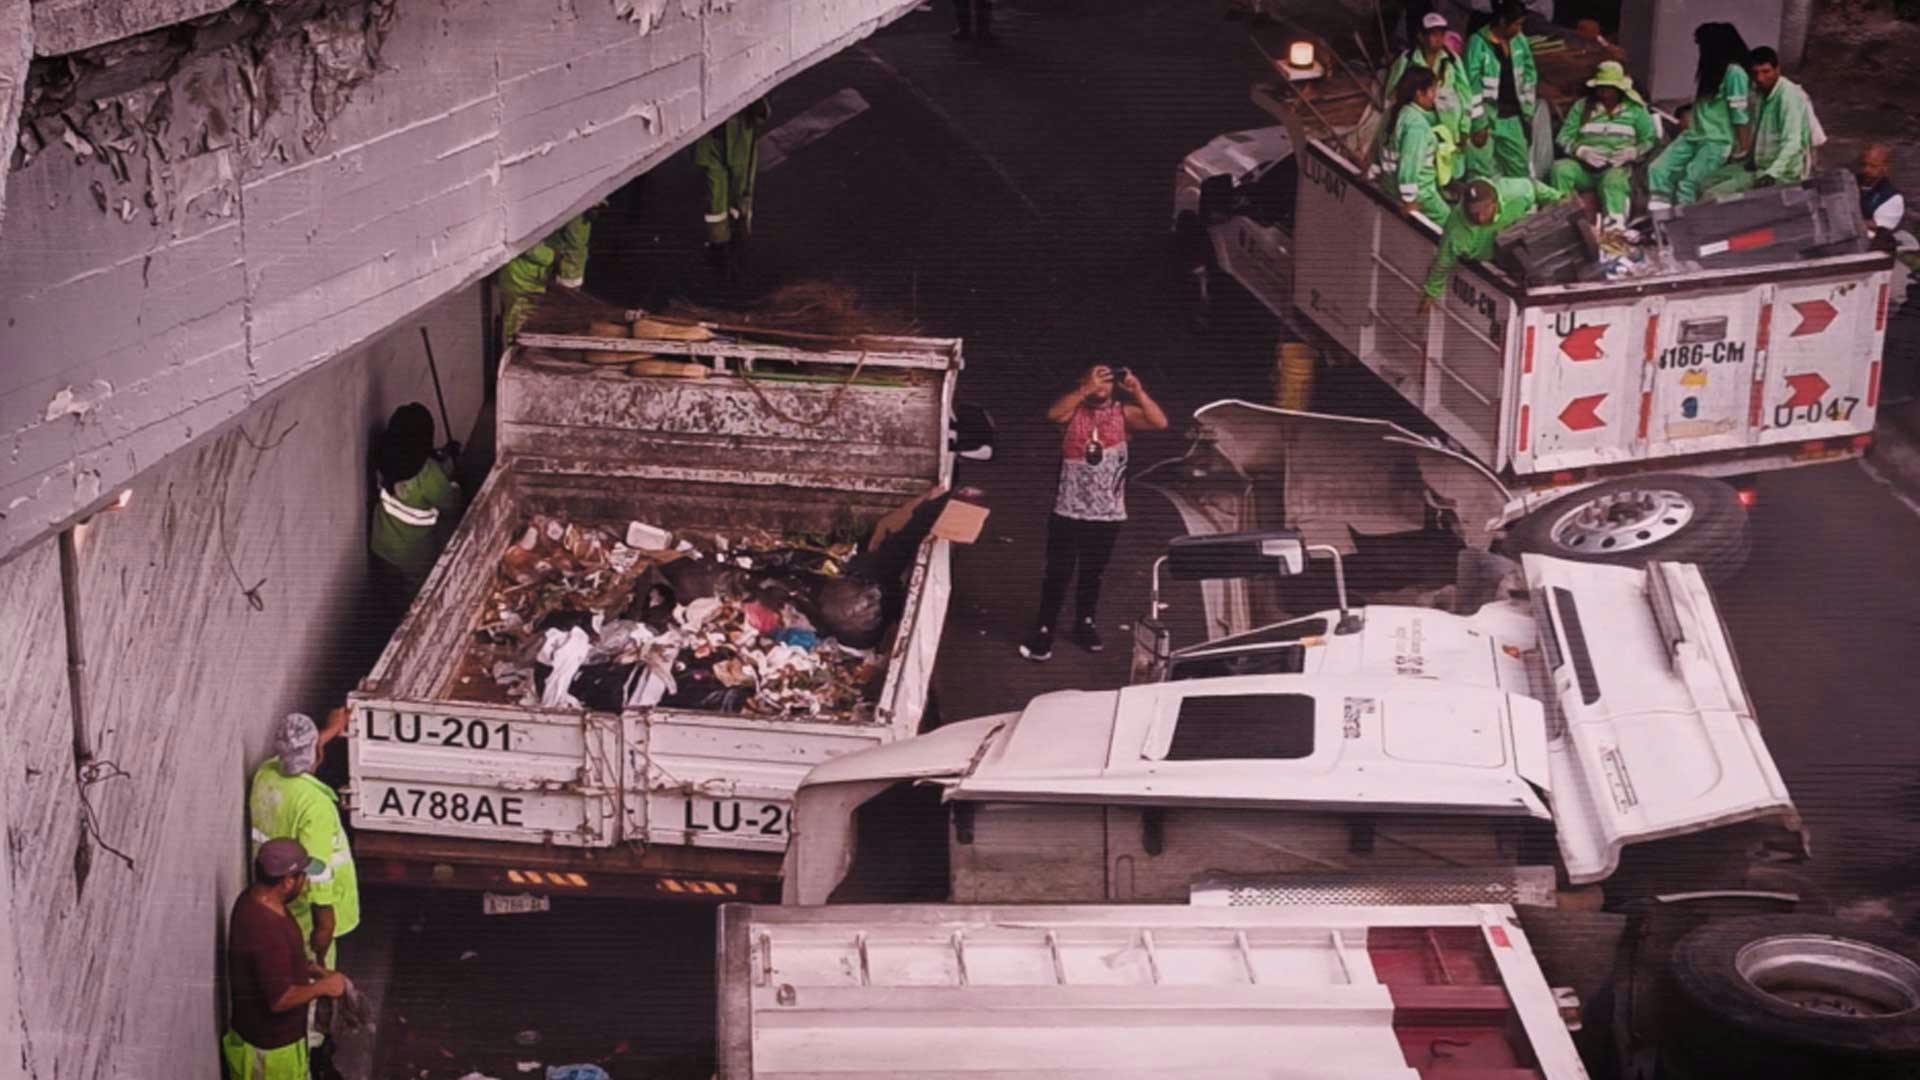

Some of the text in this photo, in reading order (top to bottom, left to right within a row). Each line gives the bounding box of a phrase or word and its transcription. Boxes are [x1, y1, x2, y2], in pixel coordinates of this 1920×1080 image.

[1760, 397, 1860, 430] U-047
[366, 711, 511, 751] LU-201
[379, 786, 524, 827] A788AE
